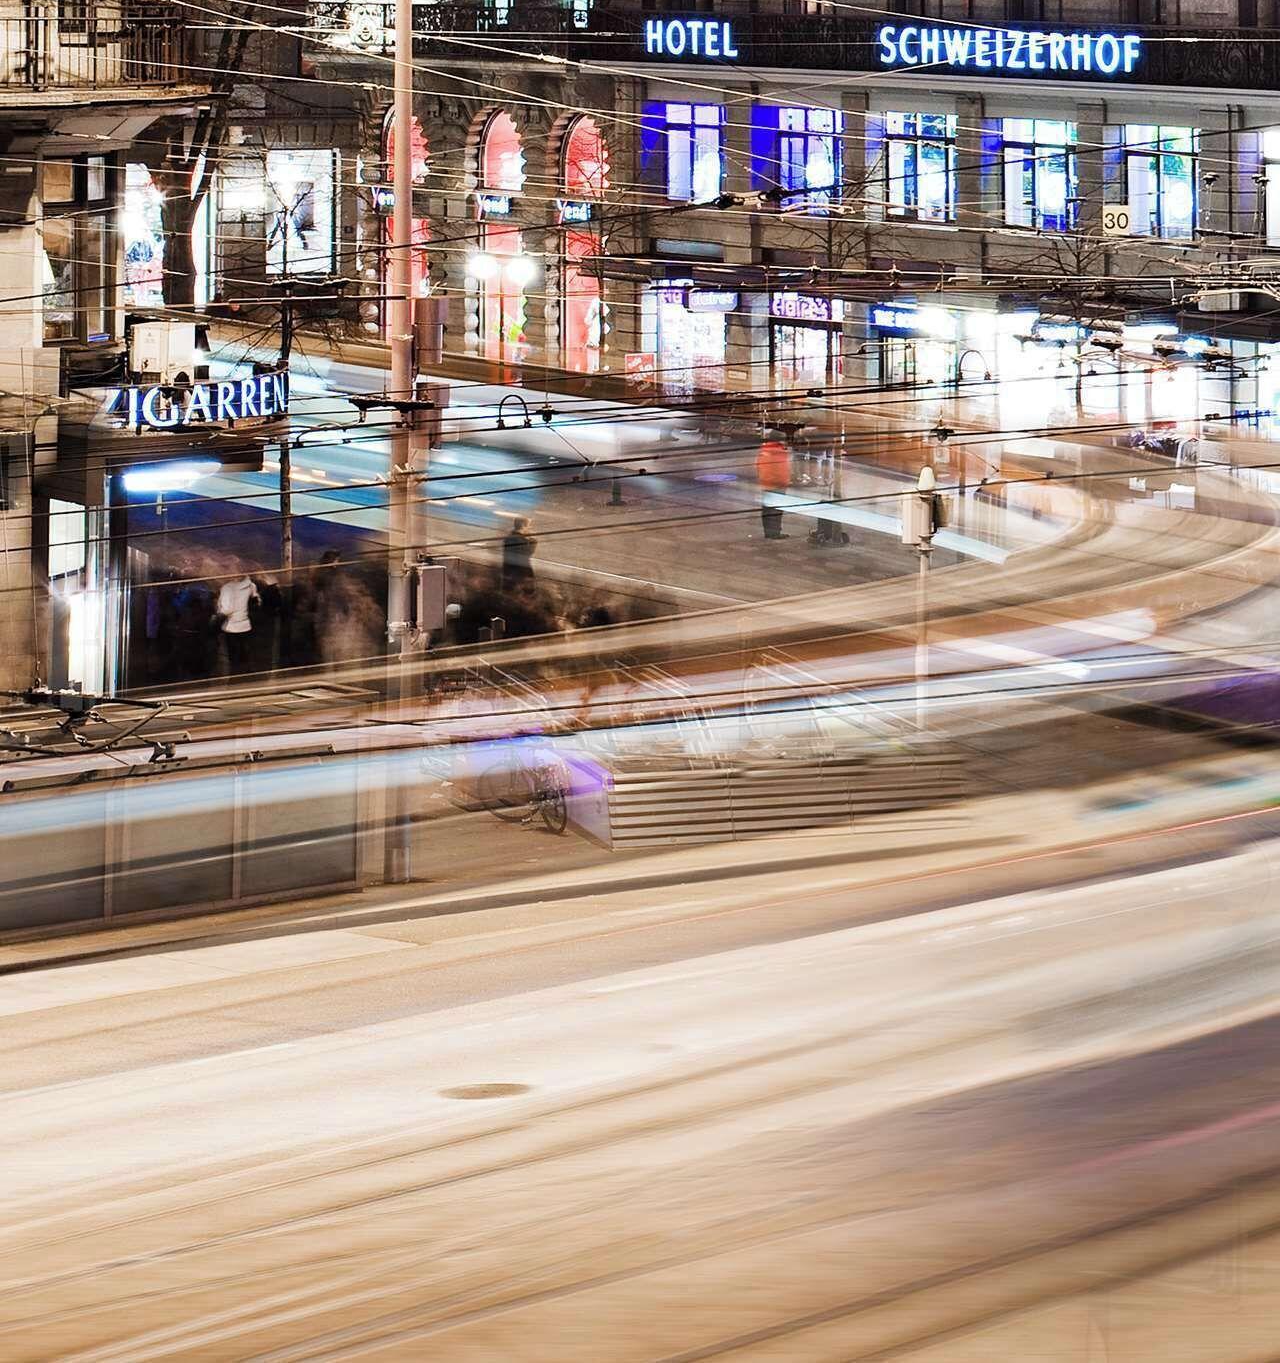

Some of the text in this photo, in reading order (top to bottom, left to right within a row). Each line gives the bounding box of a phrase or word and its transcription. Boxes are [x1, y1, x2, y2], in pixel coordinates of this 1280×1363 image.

[646, 20, 738, 57] HOTEL
[879, 26, 1141, 73] SCHWEIZERHOF
[1104, 212, 1129, 230] 30
[105, 371, 290, 427] ZIGARREN
